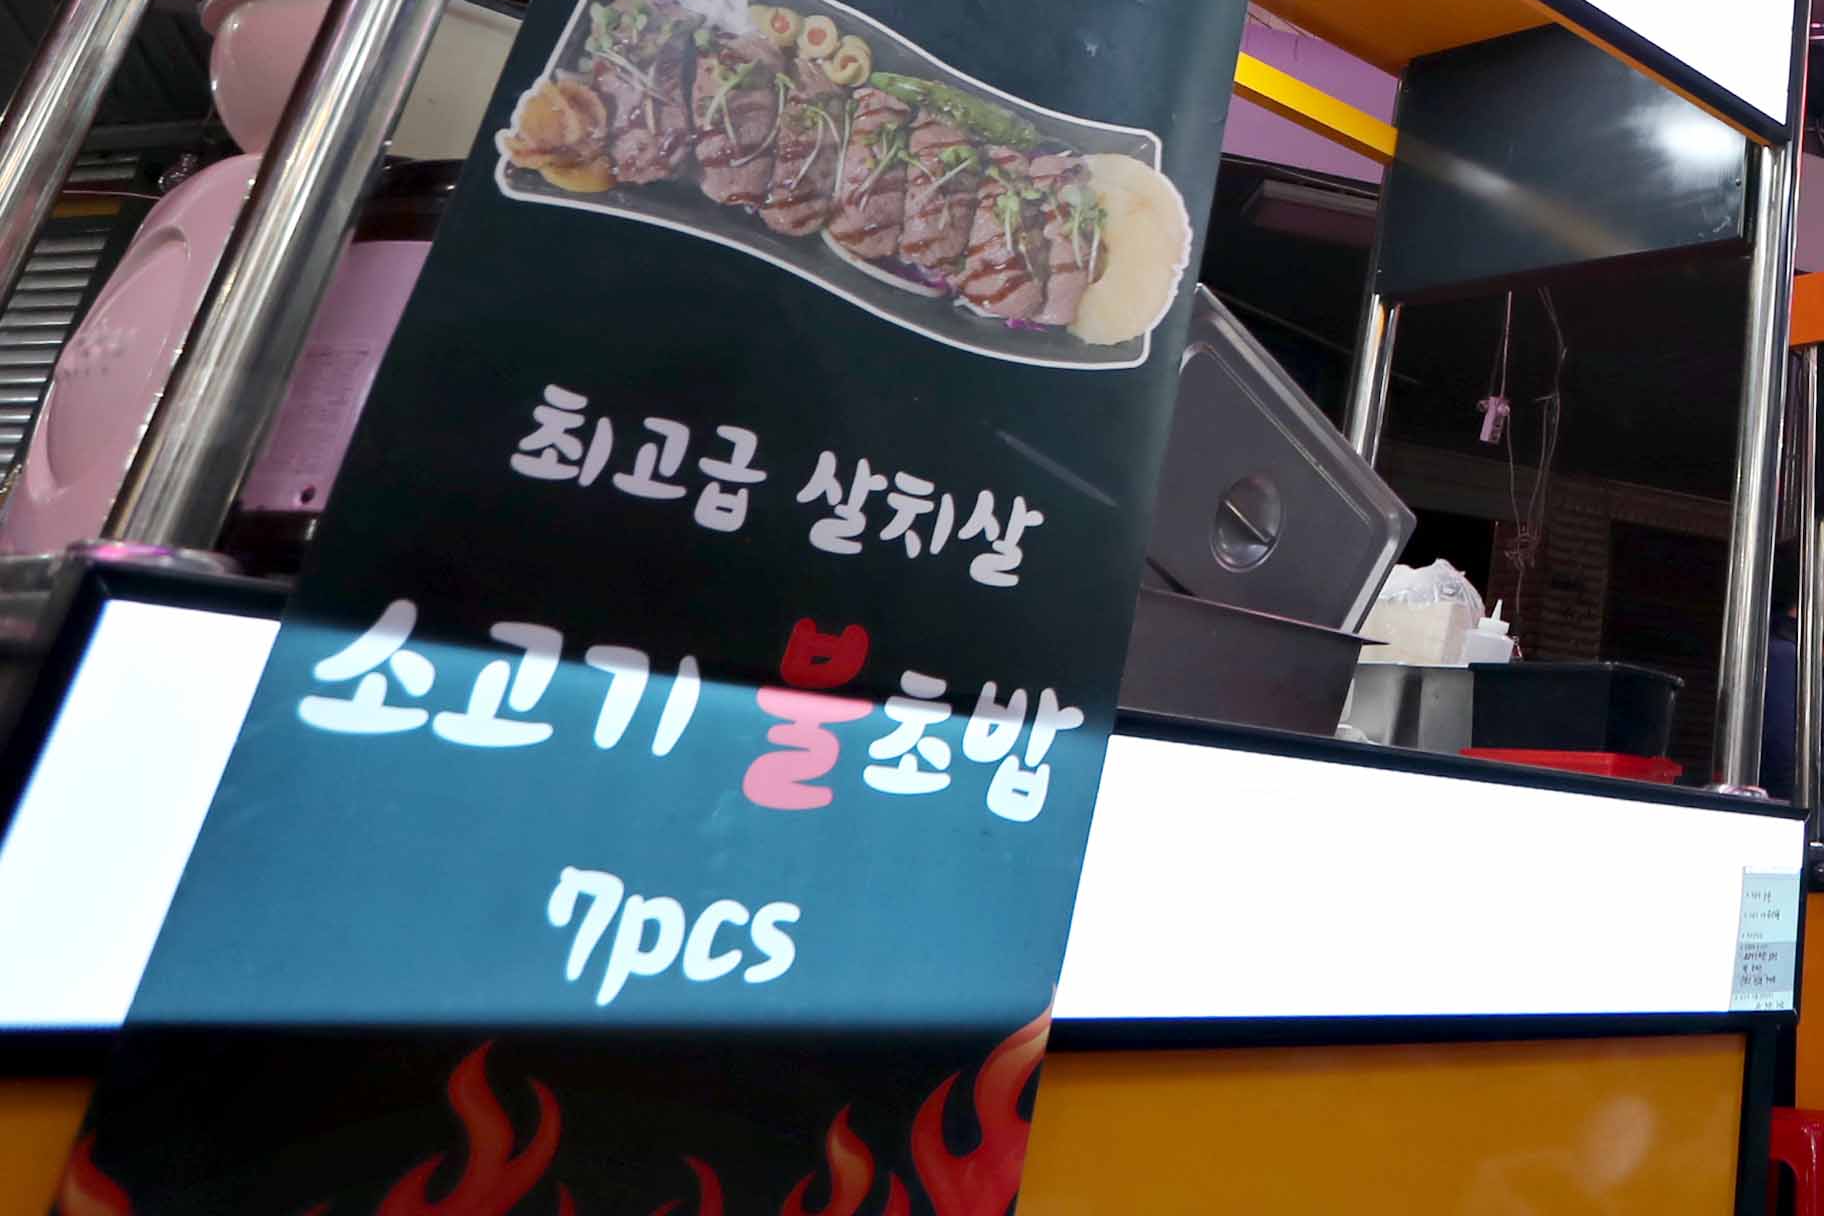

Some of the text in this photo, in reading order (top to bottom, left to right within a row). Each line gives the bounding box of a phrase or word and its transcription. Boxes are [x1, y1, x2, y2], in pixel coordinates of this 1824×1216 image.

[509, 384, 1046, 587] 최고급 살치살
[295, 598, 1085, 824] 소고기 불초밥
[546, 864, 801, 1007] 7pcs
